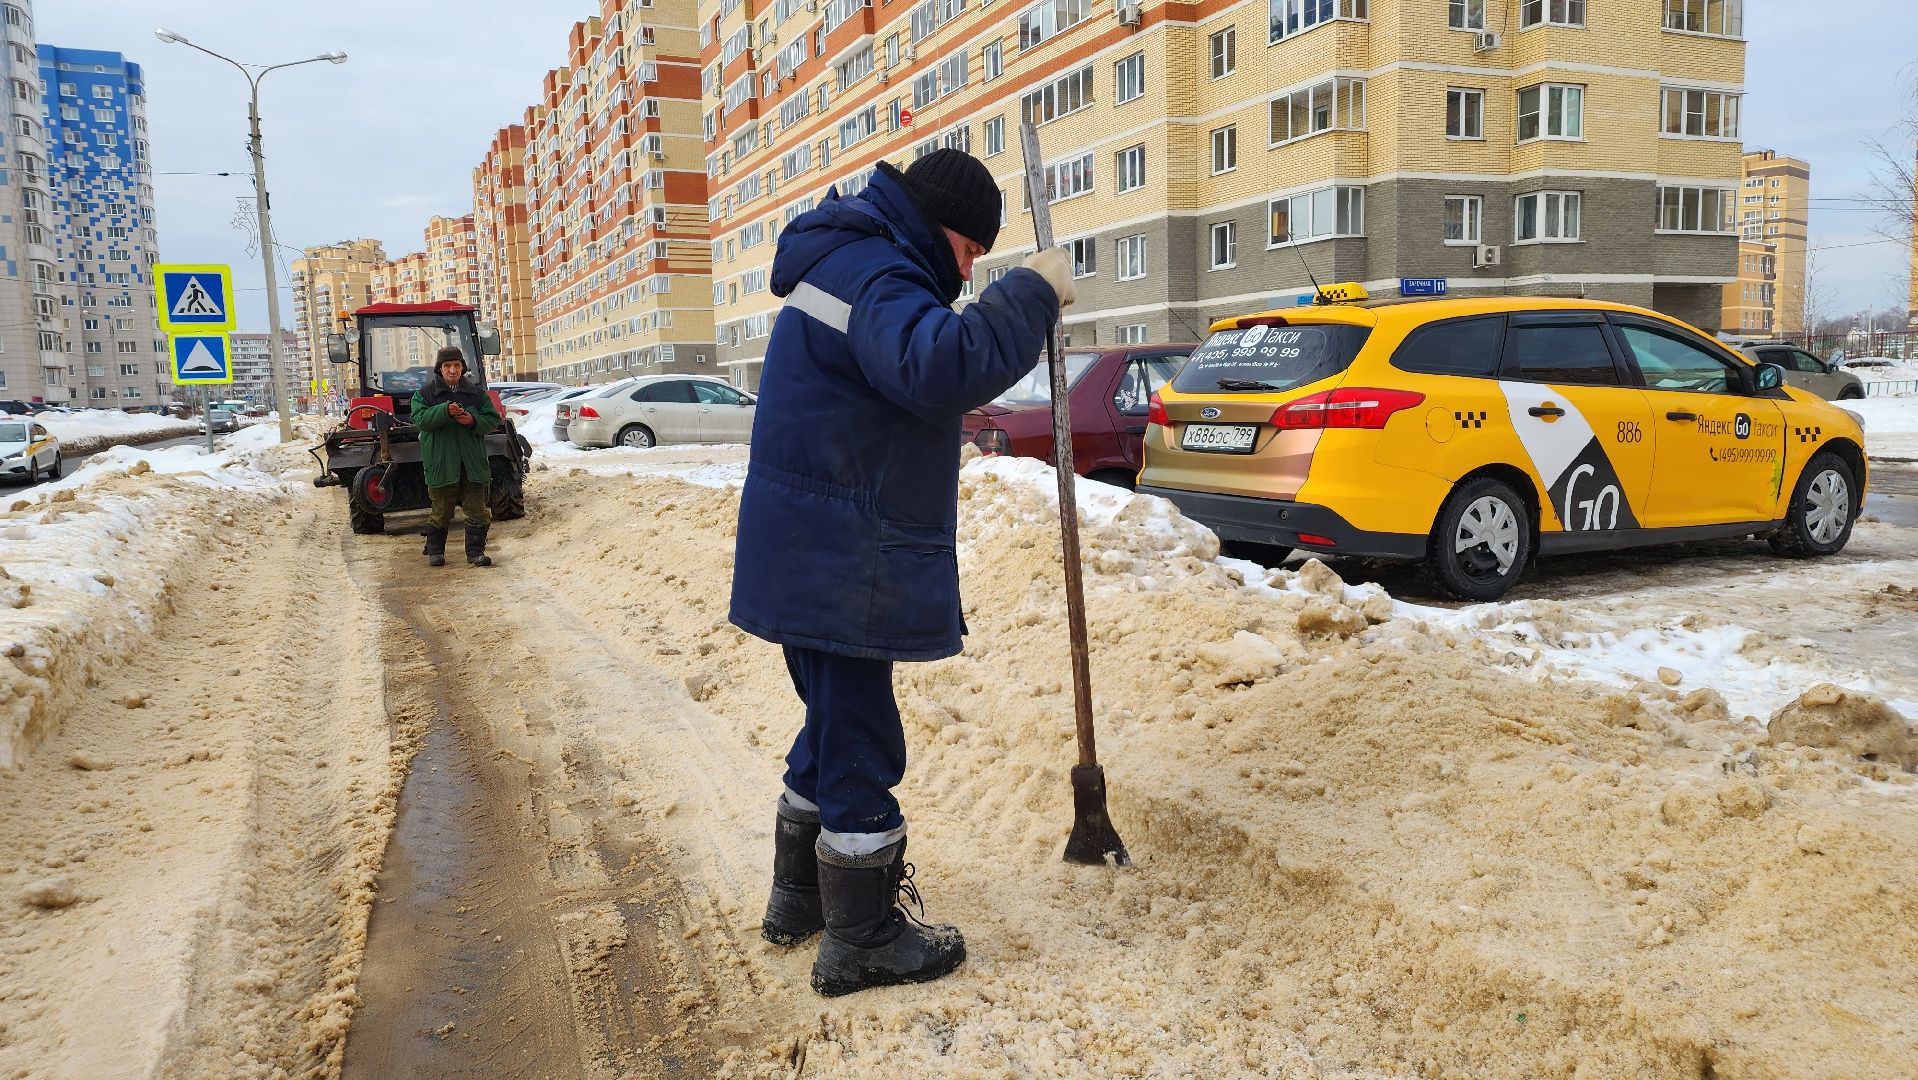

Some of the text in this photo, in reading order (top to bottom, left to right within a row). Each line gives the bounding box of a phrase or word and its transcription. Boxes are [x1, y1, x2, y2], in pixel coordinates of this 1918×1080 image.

[1437, 281, 1444, 291] 11
[1264, 328, 1301, 344] Такси
[1231, 347, 1256, 357] 999
[1280, 347, 1300, 358] 99
[1617, 420, 1642, 443] 886
[1698, 414, 1778, 437] Яндекс Go Такси
[1233, 427, 1253, 441] 799
[1564, 463, 1620, 531] Go
